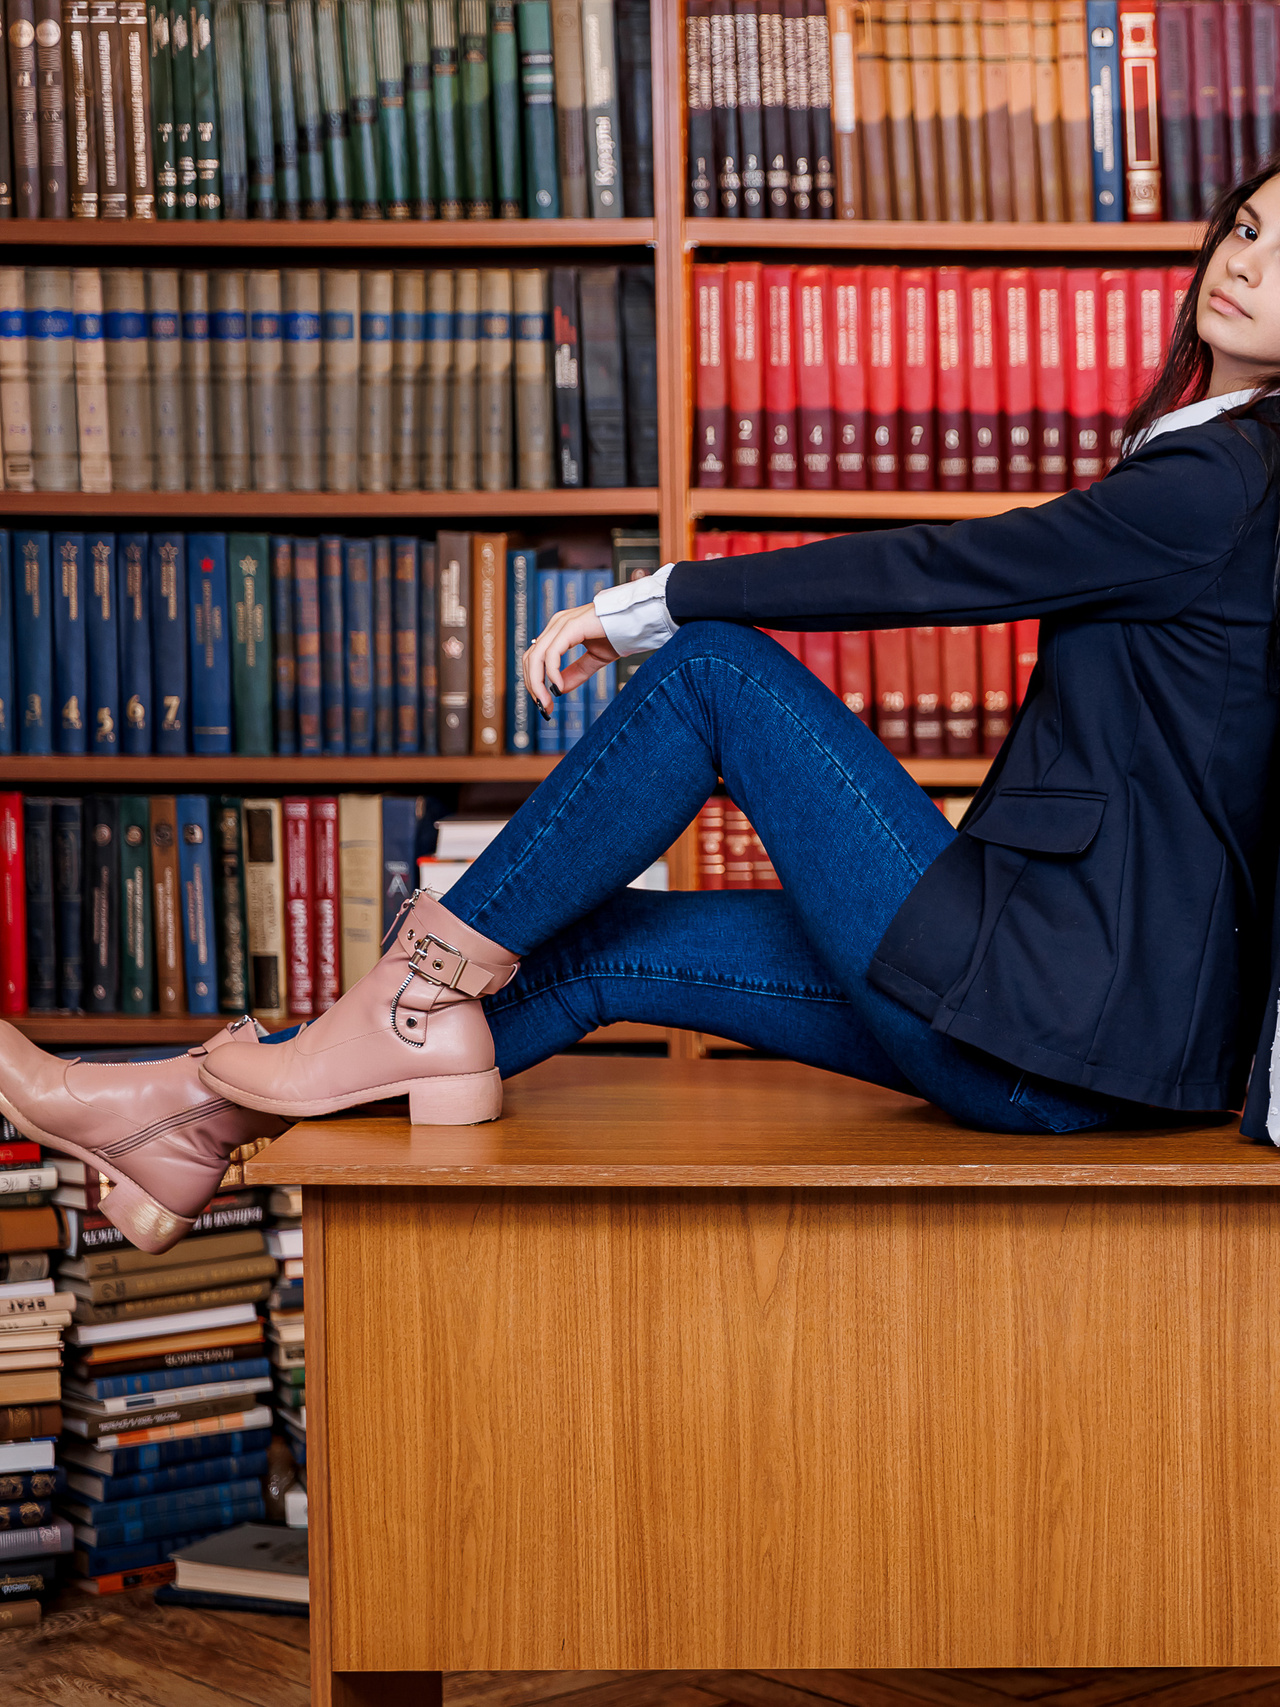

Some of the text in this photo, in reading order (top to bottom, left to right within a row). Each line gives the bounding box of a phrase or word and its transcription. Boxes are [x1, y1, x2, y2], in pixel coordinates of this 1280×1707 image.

[705, 425, 716, 446] 1
[738, 419, 753, 440] 2
[774, 424, 788, 446] 3
[809, 425, 823, 446] 4
[842, 424, 856, 445] 5
[875, 425, 889, 446] 6
[910, 425, 924, 446] 7
[945, 428, 959, 449] 8
[977, 427, 992, 447] 9
[1010, 426, 1030, 447] 10
[1078, 429, 1098, 450] 12
[62, 695, 82, 722] 4
[126, 694, 146, 726] 6
[163, 695, 181, 727] 7
[97, 706, 115, 739] 5
